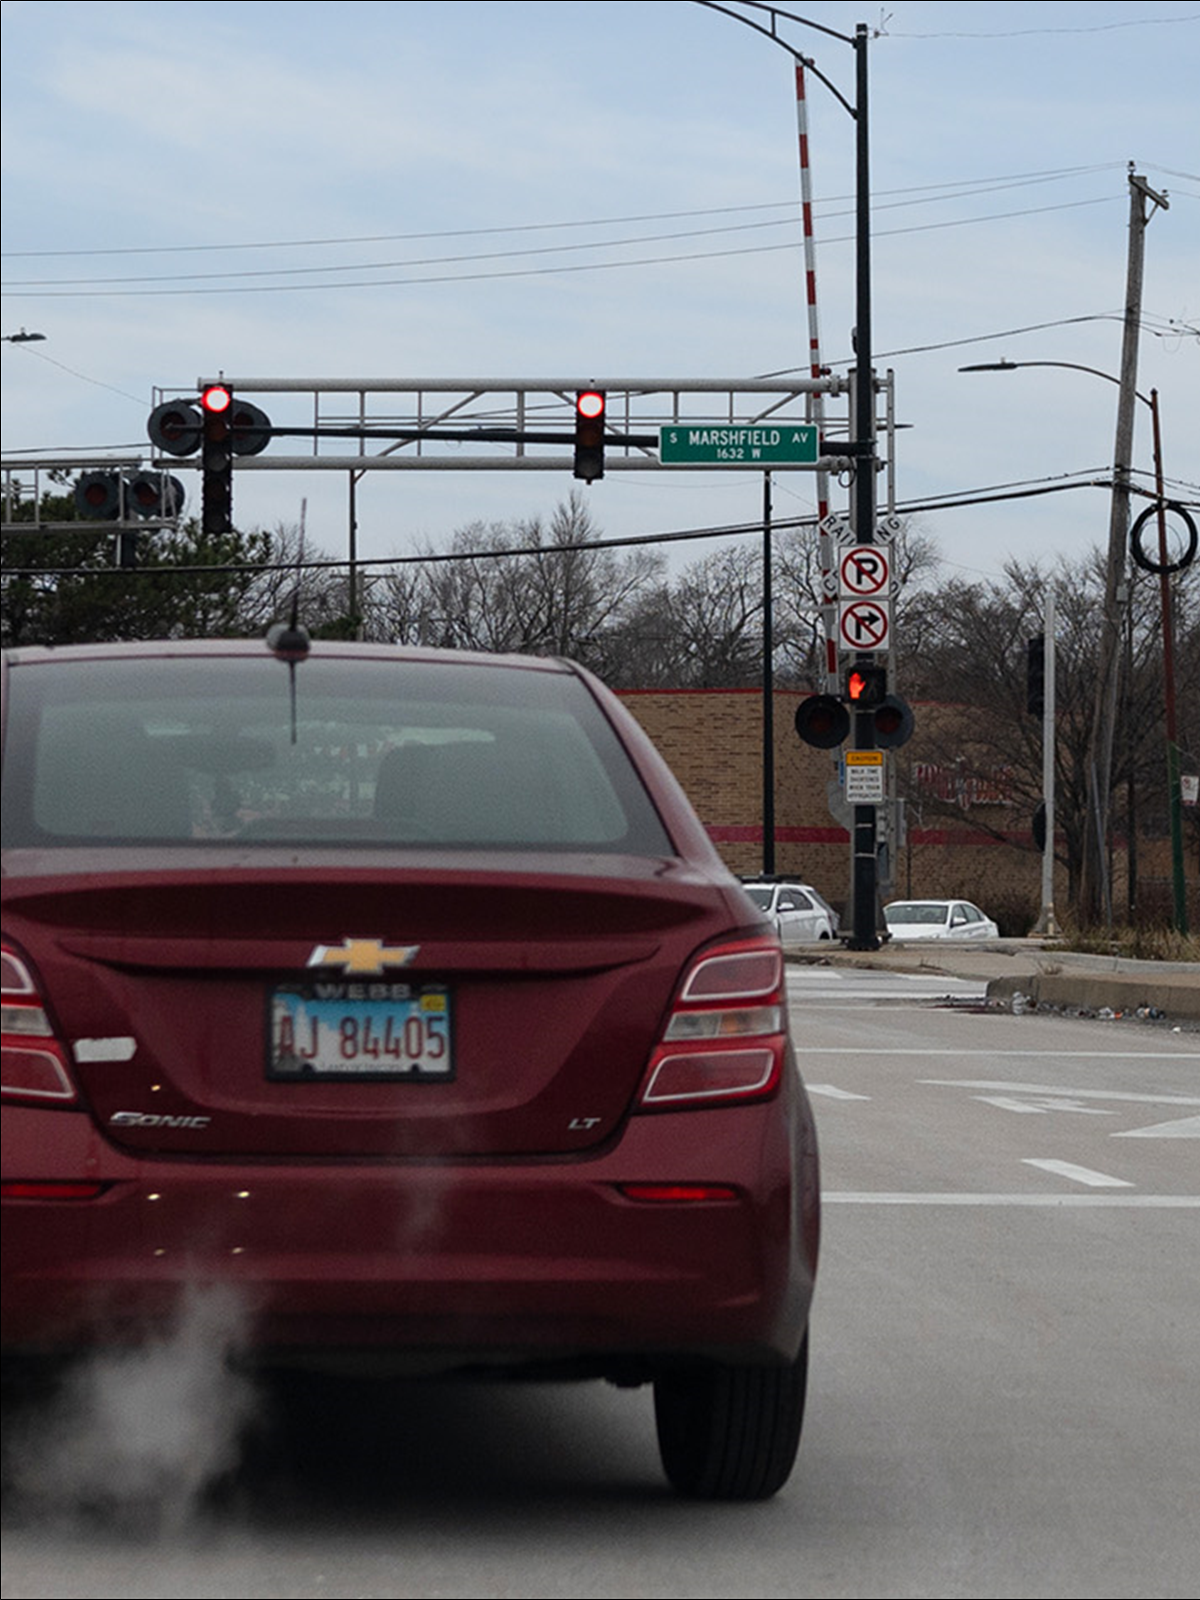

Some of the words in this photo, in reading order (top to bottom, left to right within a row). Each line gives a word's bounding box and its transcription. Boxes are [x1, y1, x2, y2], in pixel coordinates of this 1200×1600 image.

[669, 432, 678, 444] S
[689, 430, 780, 446] MARSHFIELD
[792, 432, 808, 443] AV
[717, 448, 744, 459] 1632
[752, 448, 761, 459] W
[315, 983, 411, 998] WEBB
[279, 1016, 319, 1059] AJ
[340, 1016, 446, 1059] 84405
[109, 1111, 212, 1128] SONIC
[568, 1117, 602, 1129] LT
